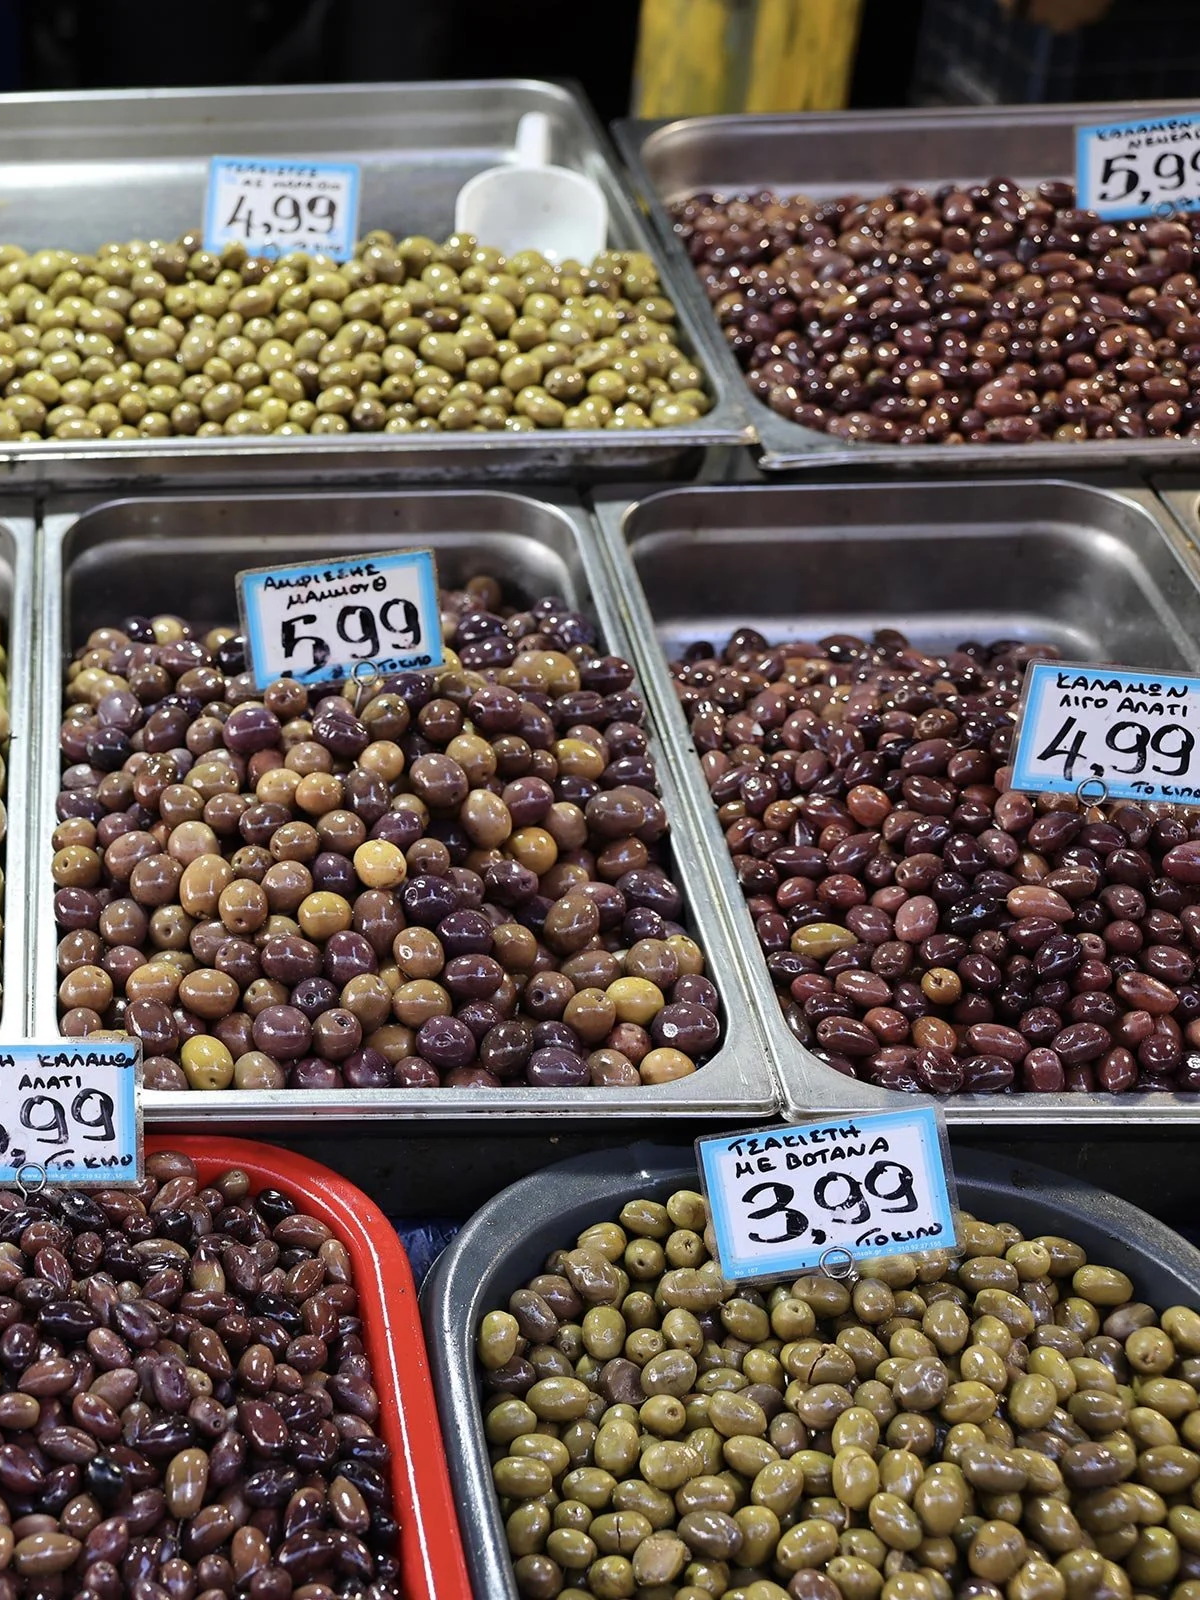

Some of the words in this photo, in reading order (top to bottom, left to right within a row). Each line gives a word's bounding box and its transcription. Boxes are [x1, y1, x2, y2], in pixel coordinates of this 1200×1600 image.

[226, 195, 337, 238] 4,99
[1056, 672, 1188, 698] ΚΑΛΑΜΩΝ
[1059, 694, 1108, 710] ΛΙΓΟ
[1116, 697, 1188, 717] ΑΛΑΤΙ
[1036, 716, 1195, 782] 4,99
[18, 1074, 82, 1091] ΑΛΑΤΙ
[728, 1124, 862, 1157] ΤΣΑΚΙΣΤΗ
[735, 1157, 777, 1179] ΜΕ
[786, 1137, 890, 1171] ΒΟΤΑΝΑ
[741, 1160, 919, 1246] 3,99
